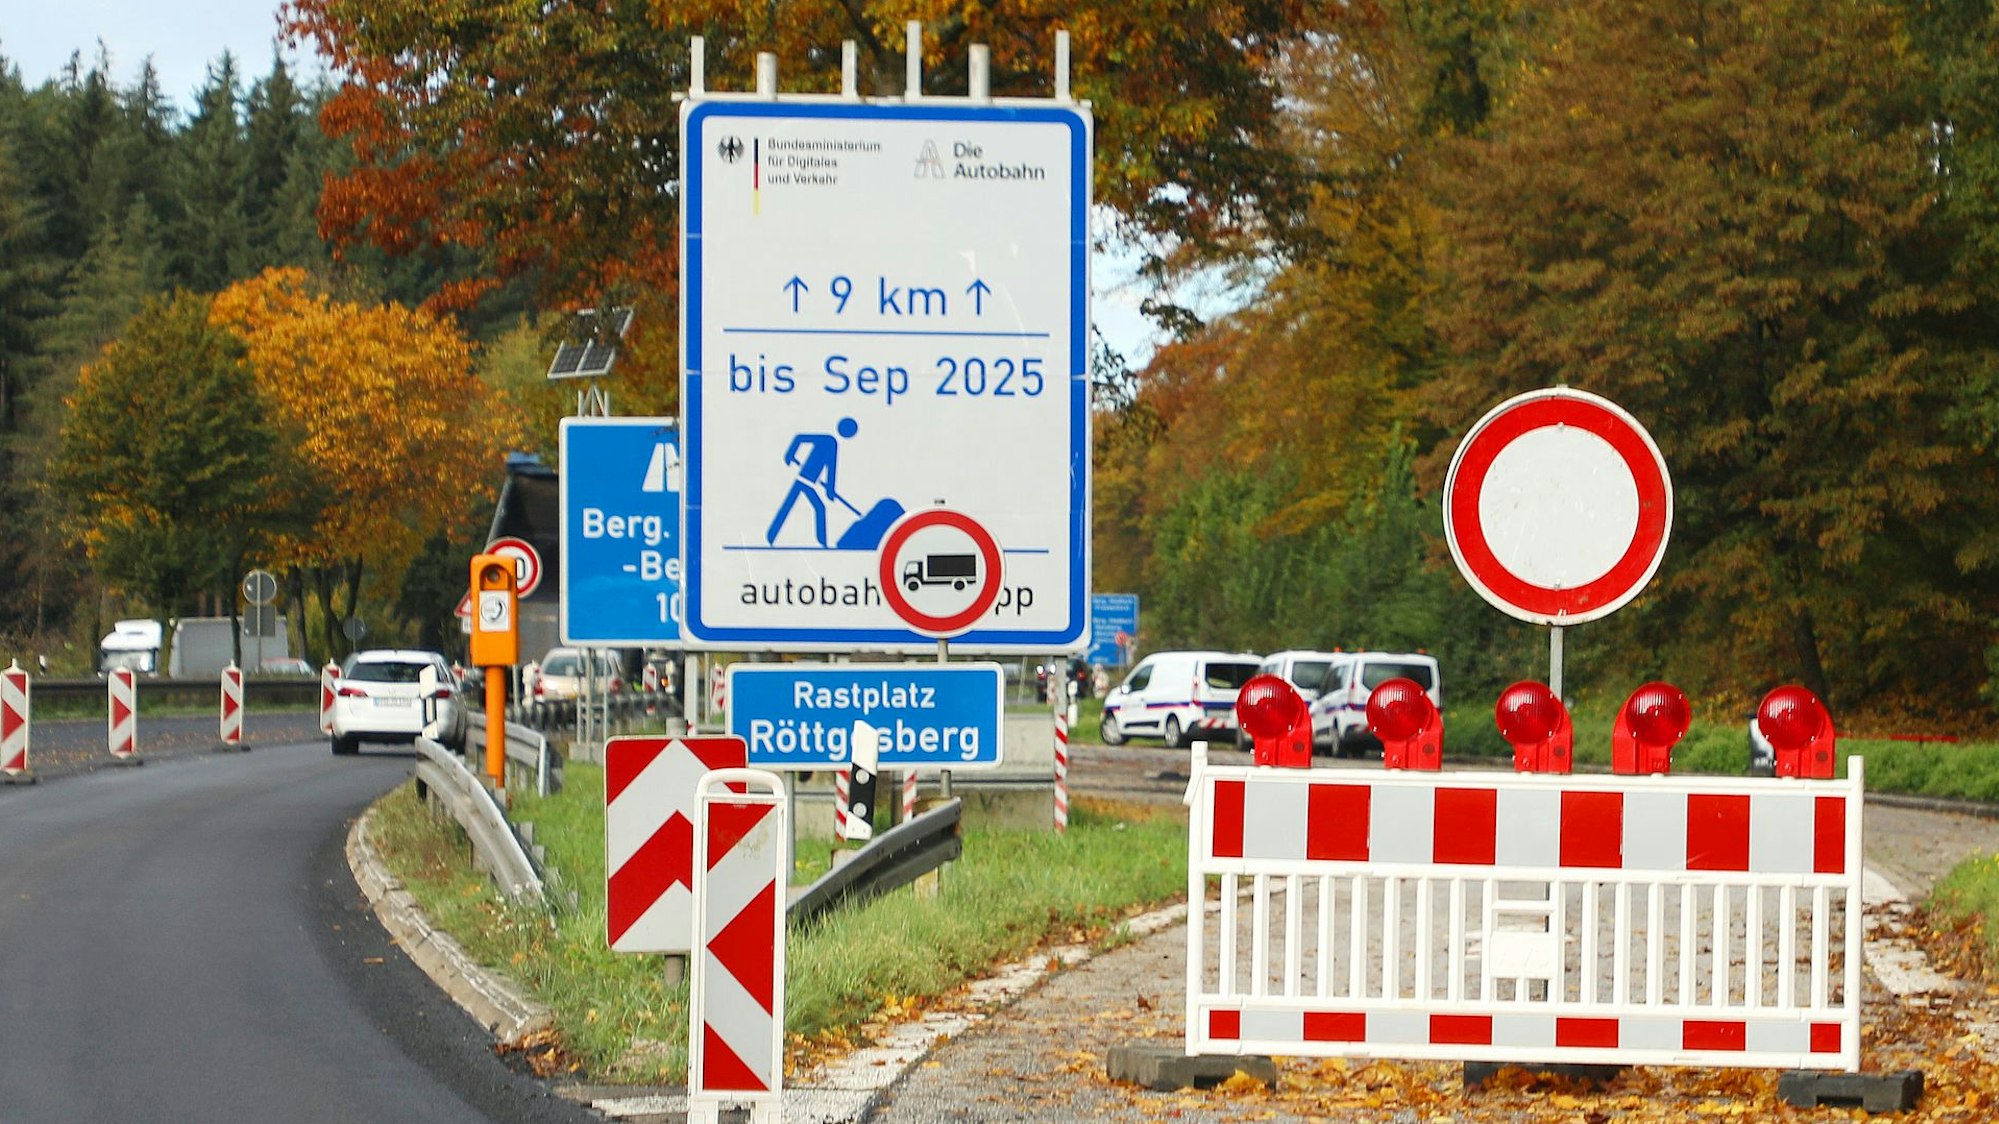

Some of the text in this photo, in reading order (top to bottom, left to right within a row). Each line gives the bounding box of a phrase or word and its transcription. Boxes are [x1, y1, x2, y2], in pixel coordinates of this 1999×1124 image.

[767, 137, 882, 152] Bundesministerium
[953, 141, 983, 159] Die
[767, 155, 838, 171] für Digitales
[953, 162, 1046, 180] Autobahn
[767, 172, 838, 185] und Verkehr
[829, 275, 947, 317] 9 km
[729, 353, 1044, 407] bis Sep 2025
[582, 507, 671, 546] Berg.
[794, 680, 936, 715] Rastplatz
[750, 718, 979, 761] Röttgsberg
